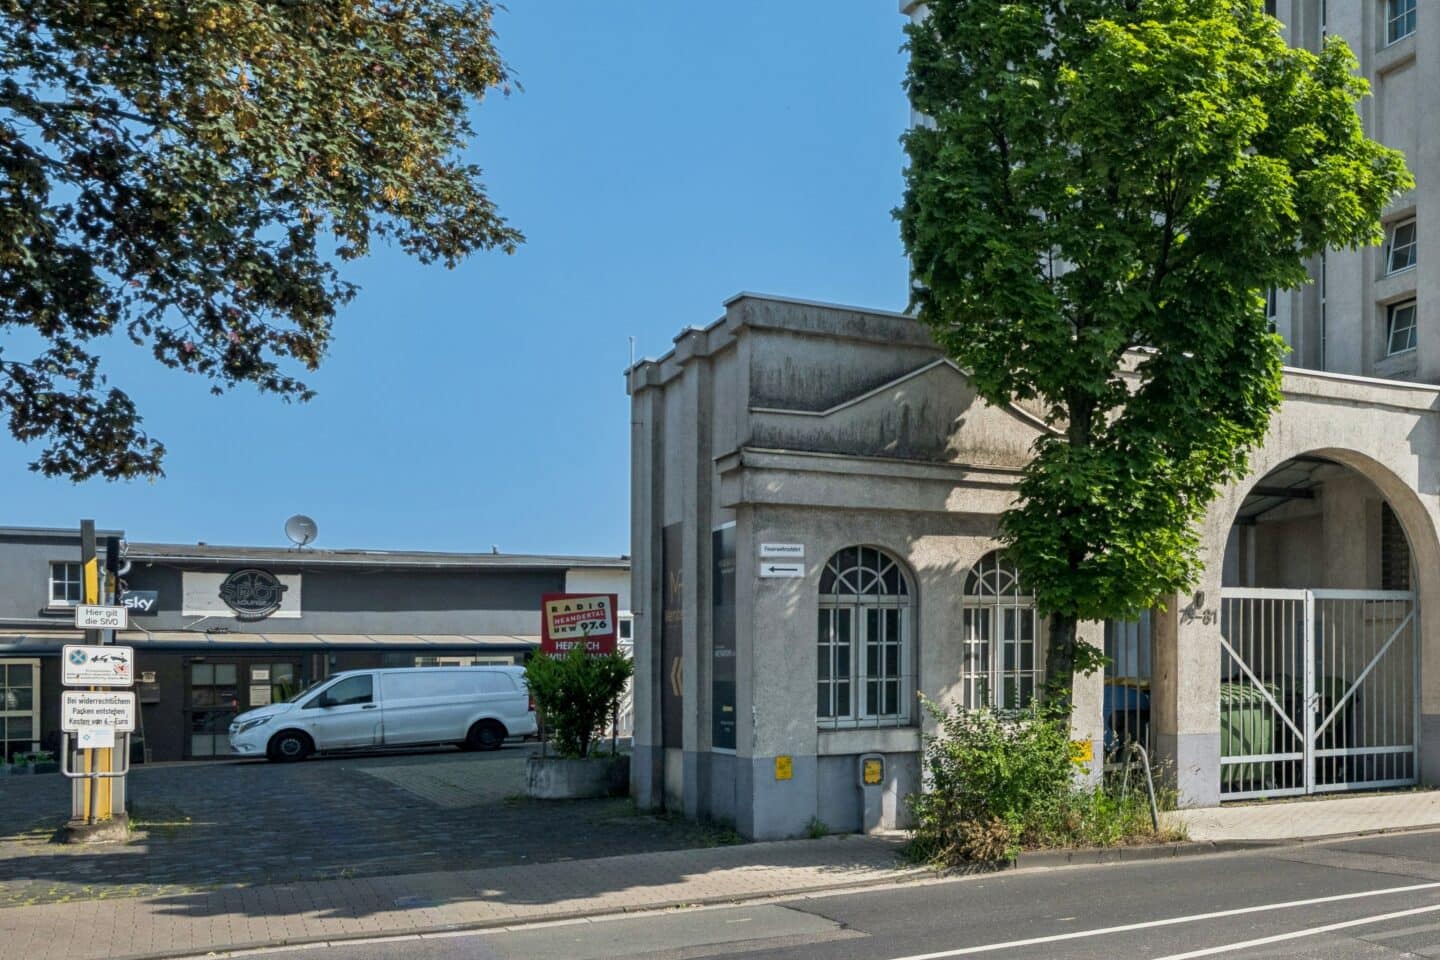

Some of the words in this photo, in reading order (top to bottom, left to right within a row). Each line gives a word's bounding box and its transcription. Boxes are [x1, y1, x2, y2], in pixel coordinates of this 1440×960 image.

[124, 596, 154, 611] sky
[551, 601, 605, 613] RADIO
[85, 608, 102, 616] Hier
[554, 609, 604, 626] NEANDERTAL
[85, 617, 98, 625] die
[553, 625, 577, 633] UKW
[580, 620, 607, 631] 97.6
[555, 641, 600, 650] HERZCH
